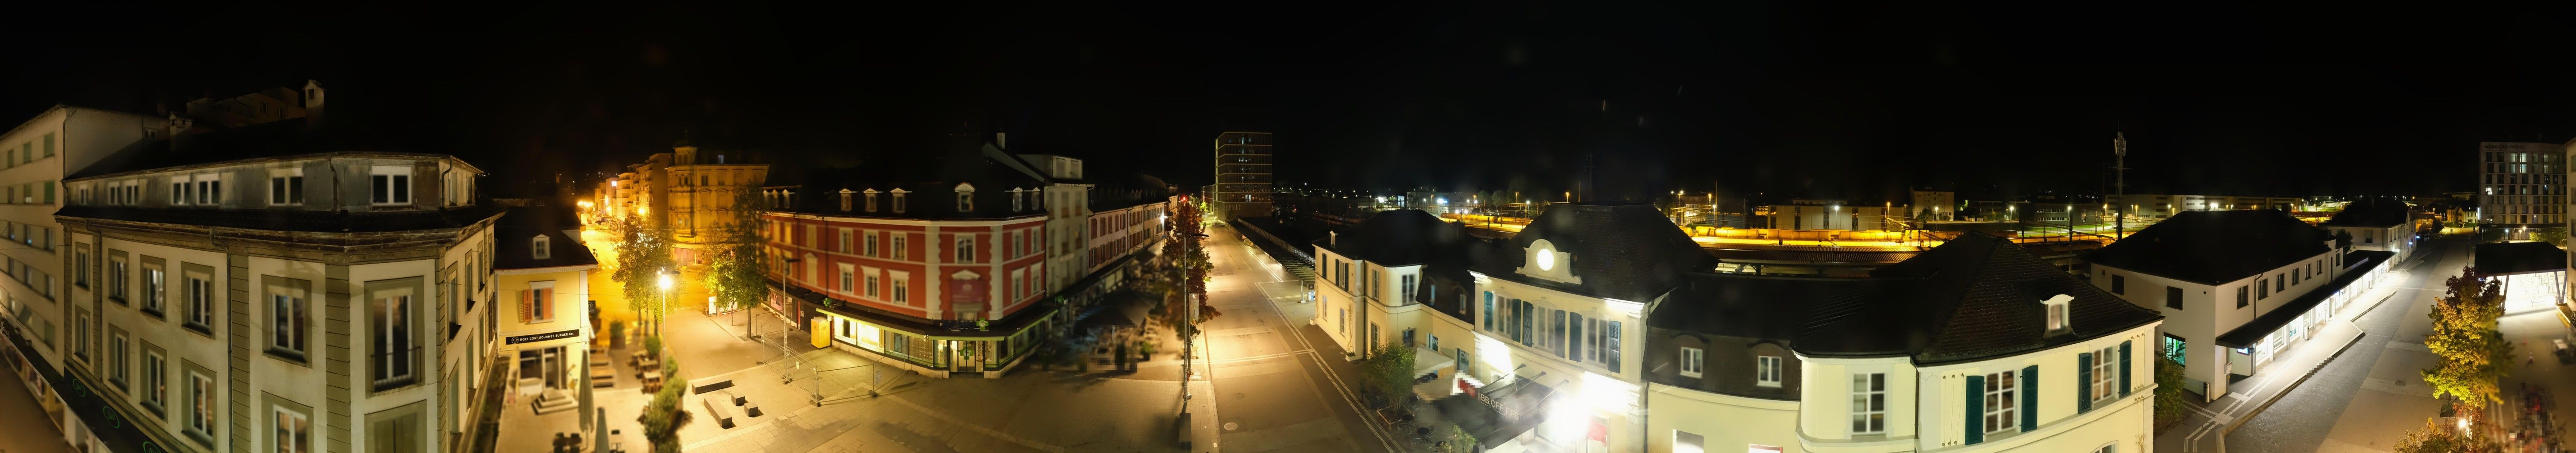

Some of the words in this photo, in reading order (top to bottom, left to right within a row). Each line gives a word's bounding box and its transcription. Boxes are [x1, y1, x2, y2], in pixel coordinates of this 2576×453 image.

[1480, 393, 1489, 404] BB
[1491, 399, 1503, 411] CFF
[1506, 407, 1519, 420] FFS
